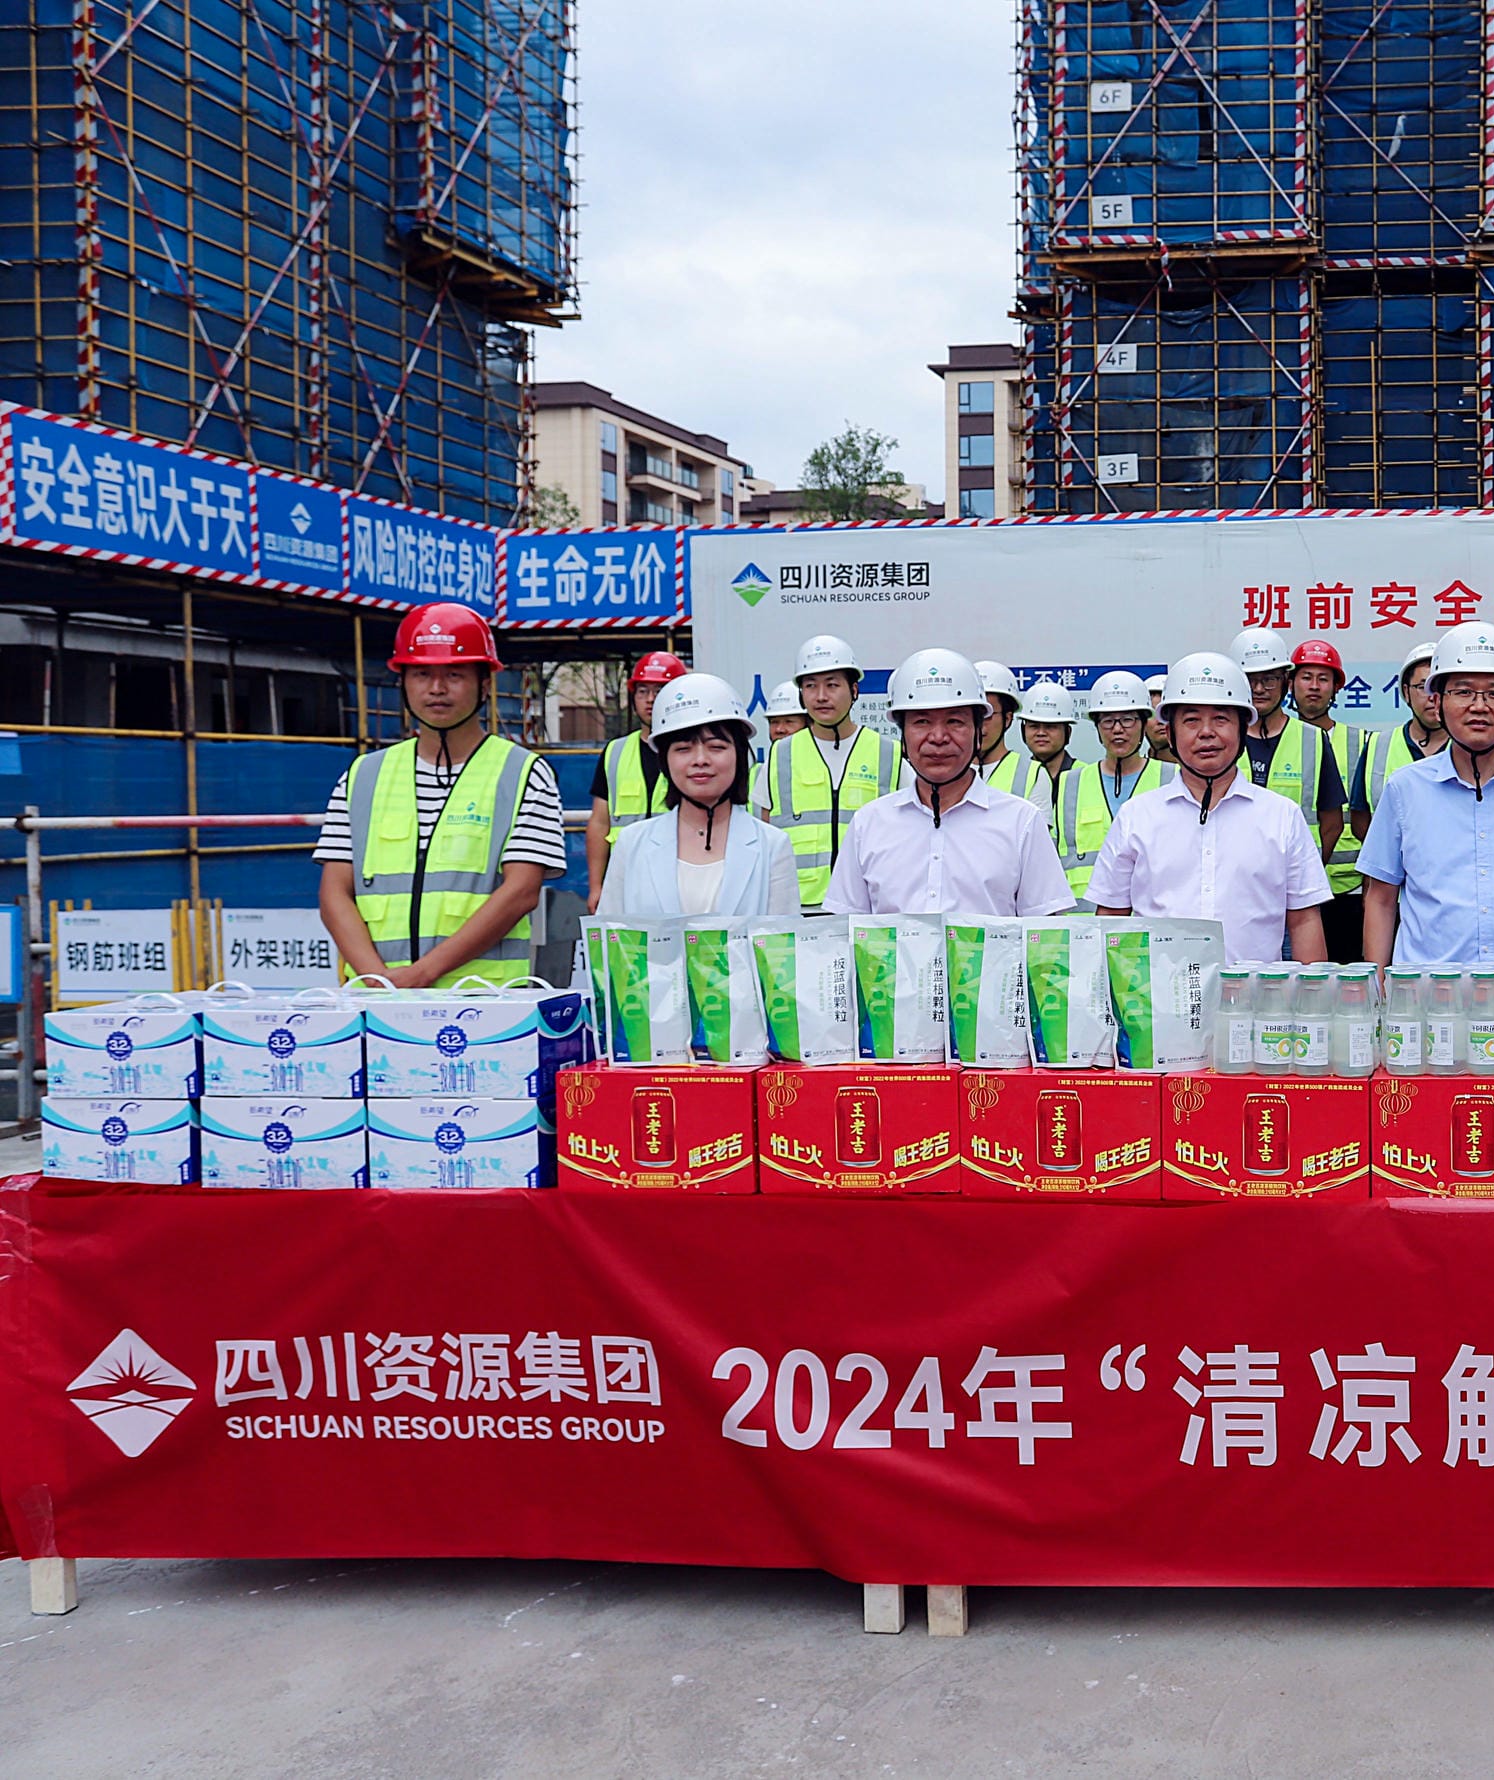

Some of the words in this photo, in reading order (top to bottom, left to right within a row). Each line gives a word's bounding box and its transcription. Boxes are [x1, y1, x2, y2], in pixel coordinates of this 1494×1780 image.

[1099, 88, 1122, 104] 6F
[1101, 203, 1123, 218] 5F
[1105, 351, 1129, 366] 4F
[1106, 461, 1129, 476] 3F
[20, 434, 249, 558] 安全意识大于天
[353, 515, 493, 602] 风险防控在身边
[516, 544, 666, 606] 生命无价
[779, 561, 931, 591] 四川资源集团
[780, 593, 827, 604] SICHUAN
[829, 592, 890, 602] RESOURCES
[893, 591, 931, 601] GROUP
[915, 677, 953, 685] 四川资源集团
[1188, 677, 1225, 685] 四川资源集团
[67, 942, 167, 972] 钢筋班组
[230, 938, 332, 970] 外架班组
[833, 957, 847, 1023] 板蓝根颗粒
[646, 1103, 661, 1154] 王老吉
[850, 1102, 865, 1154] 王老吉
[1051, 1106, 1067, 1157] 王老吉
[1258, 1110, 1274, 1162] 王老吉
[1466, 1111, 1482, 1163] 王老吉
[568, 1133, 620, 1167] 怕上火
[689, 1133, 742, 1167] 喝王老吉
[771, 1133, 823, 1167] 怕上火
[894, 1132, 950, 1167] 喝王老吉
[971, 1135, 1024, 1171] 怕上火
[1095, 1138, 1151, 1172] 喝王老吉
[1176, 1139, 1229, 1175] 怕上火
[1302, 1142, 1360, 1177] 喝王老吉
[1383, 1142, 1437, 1177] 怕上火
[214, 1331, 661, 1407] 四川资源集团
[226, 1416, 365, 1441] SICHUAN
[372, 1415, 553, 1442] RESOURCES
[560, 1416, 666, 1443] GROUP
